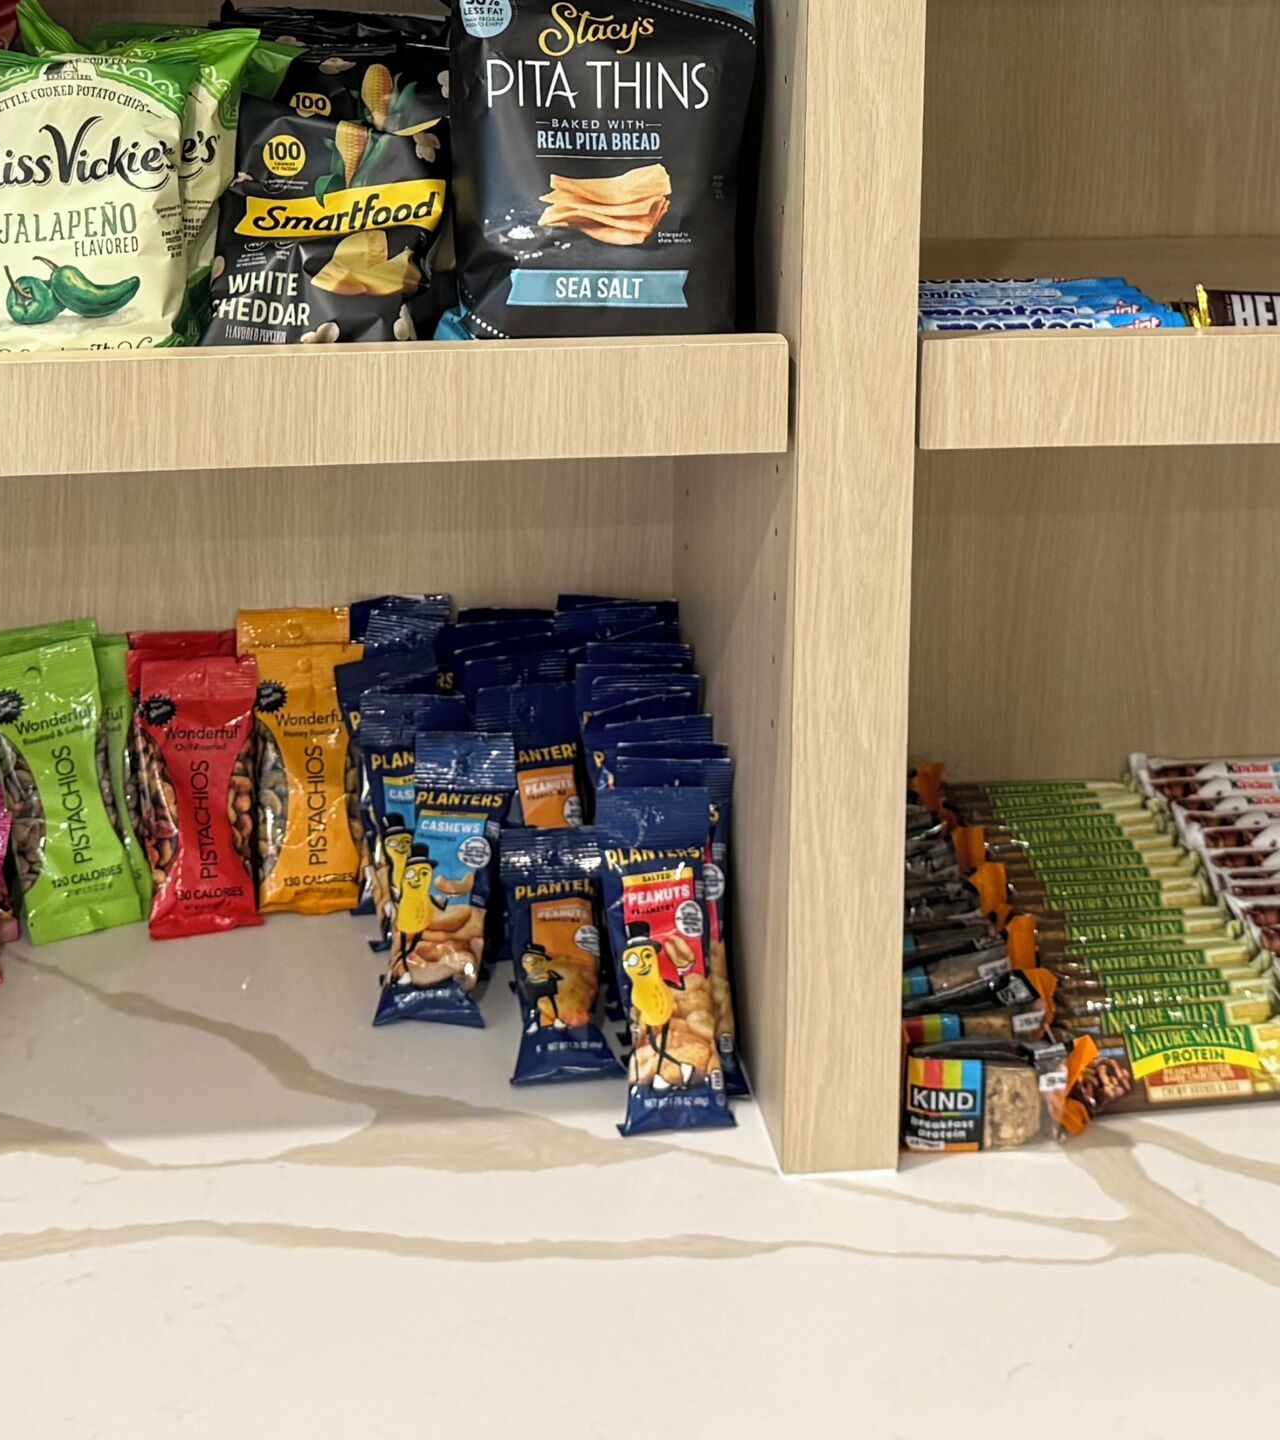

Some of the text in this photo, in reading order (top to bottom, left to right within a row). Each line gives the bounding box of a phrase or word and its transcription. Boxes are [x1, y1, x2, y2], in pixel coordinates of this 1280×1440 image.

[537, 0, 655, 57] Stacy's
[486, 59, 711, 111] PITA THINS
[551, 118, 647, 130] BAKED WITH
[537, 130, 661, 151] REAL PITA BREAD
[251, 194, 437, 234] Smartfood
[227, 272, 299, 299] WHITE
[554, 276, 644, 300] SEA SALT
[163, 726, 239, 741] Wonderful
[50, 744, 93, 865] PISTACHIOS
[304, 744, 328, 866] PISTACHIOS
[415, 789, 505, 809] PLANTERS
[190, 759, 219, 881] PISTACHIOS
[420, 820, 482, 835] CASHEWS
[626, 883, 692, 906] PEANUTS
[1129, 1026, 1248, 1063] NATURE VALLEY
[1162, 1048, 1227, 1066] PROTEIN
[912, 1088, 976, 1111] KIND
